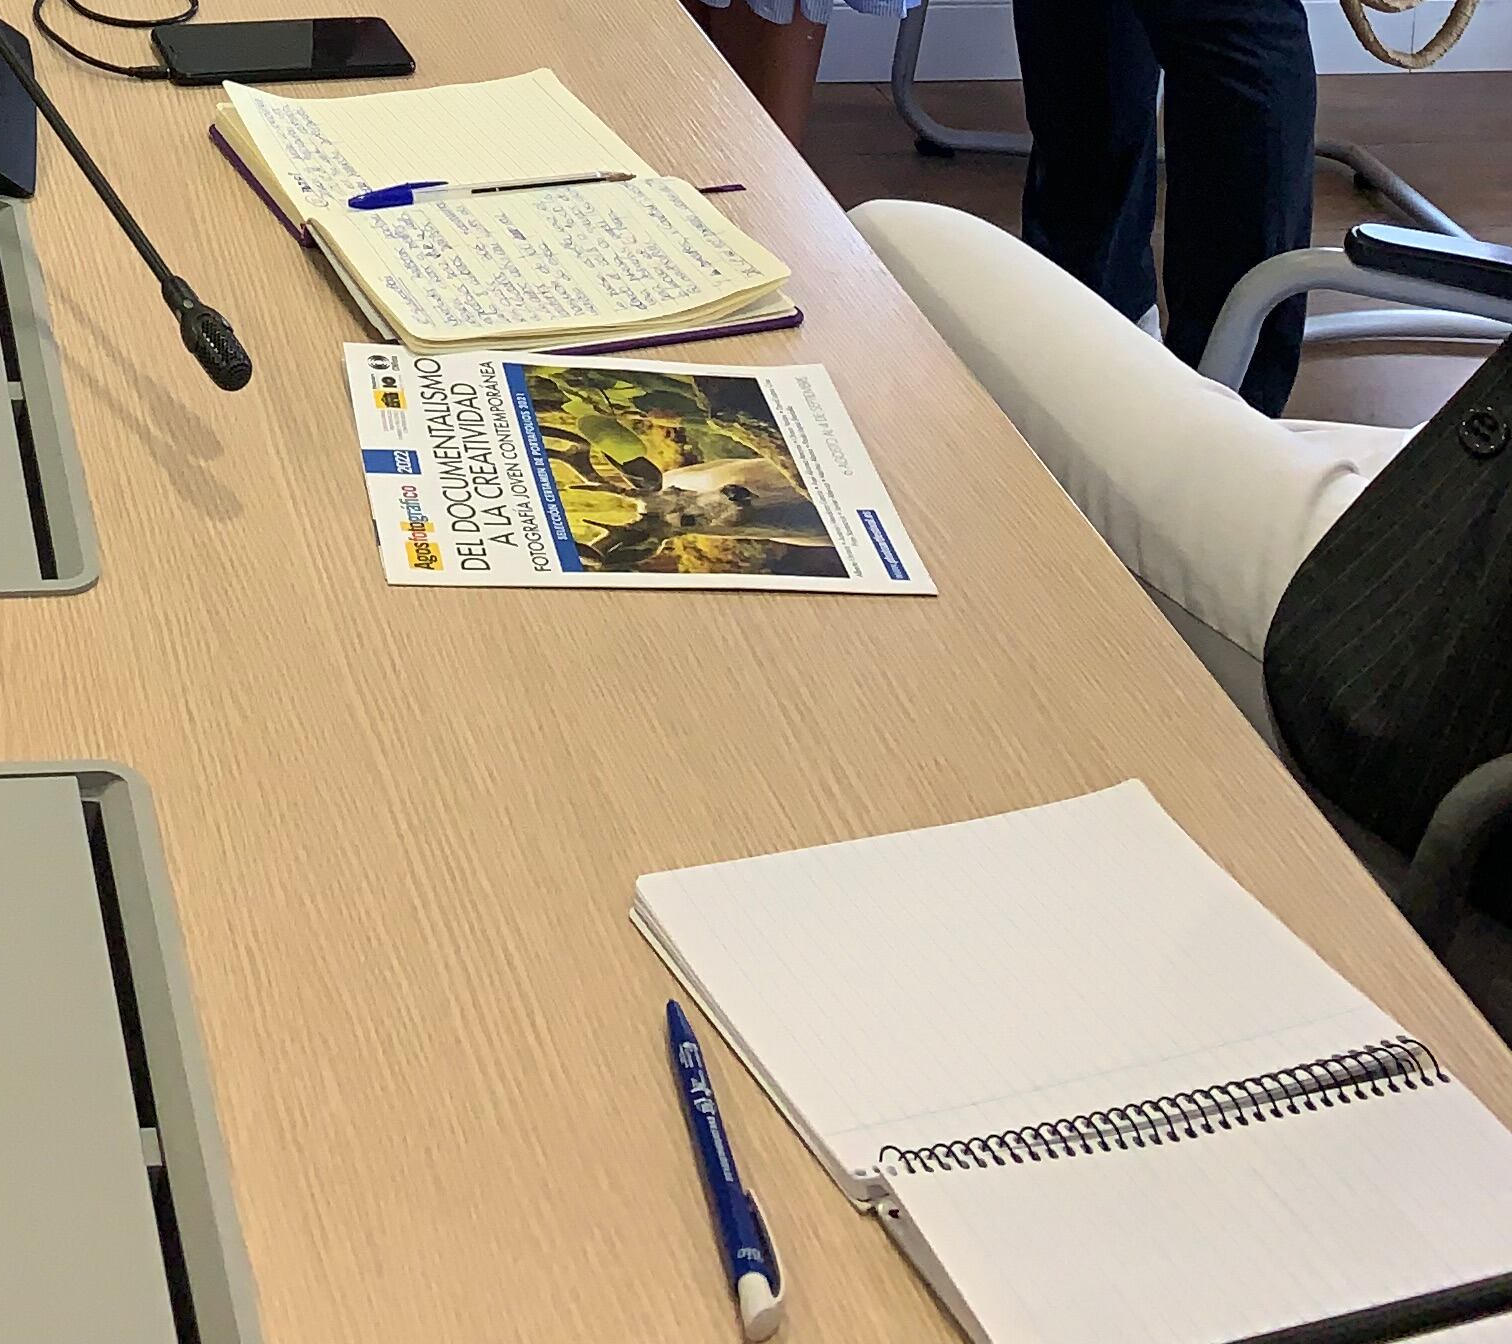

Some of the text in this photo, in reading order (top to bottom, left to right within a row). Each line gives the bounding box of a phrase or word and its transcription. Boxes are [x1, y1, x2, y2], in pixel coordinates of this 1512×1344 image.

[393, 451, 413, 474] 2022
[413, 358, 491, 571] DEL DOCUMENTALISMO
[450, 382, 519, 547] A LA CREATIVIDAD
[479, 361, 552, 572] FOTOGRAFÍA JOVEN CONTEMPORÁNEA
